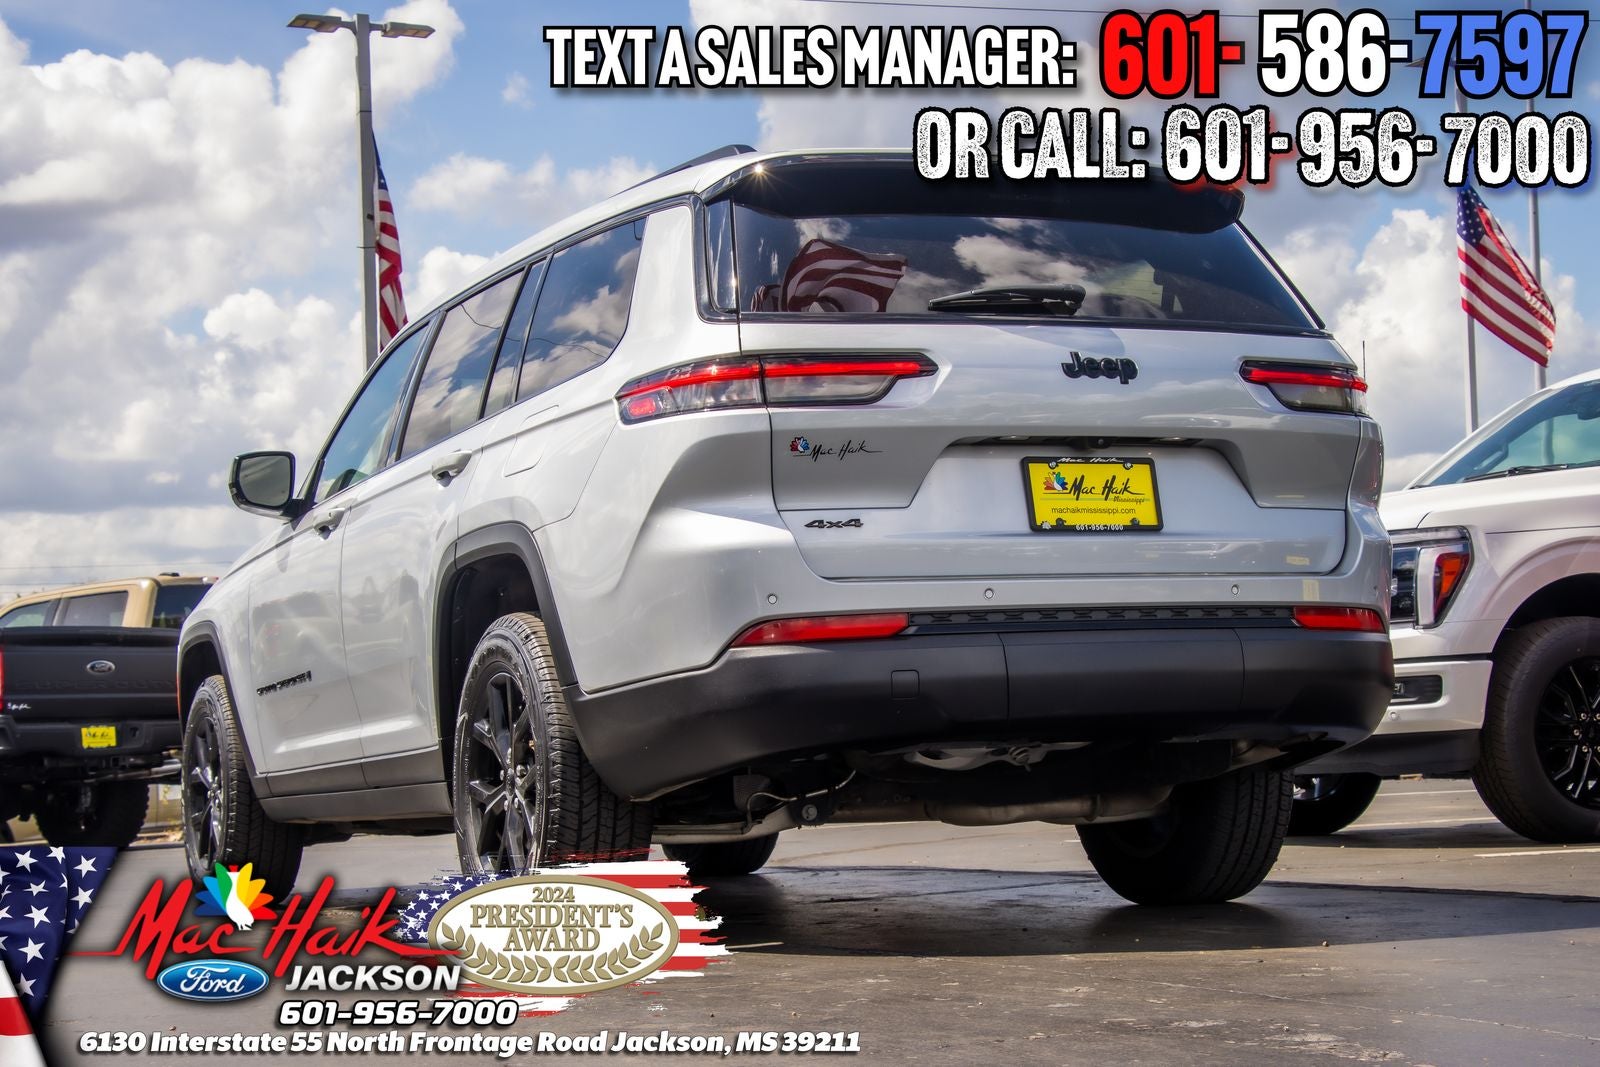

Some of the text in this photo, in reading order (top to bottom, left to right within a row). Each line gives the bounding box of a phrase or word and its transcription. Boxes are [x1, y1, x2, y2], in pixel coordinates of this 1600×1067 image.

[1061, 351, 1138, 384] Jeep
[809, 440, 880, 462] Mac Haik
[1068, 474, 1142, 501] Mac Haik
[1051, 507, 1136, 515] machaikmississippi.com
[804, 519, 864, 528] 4x4
